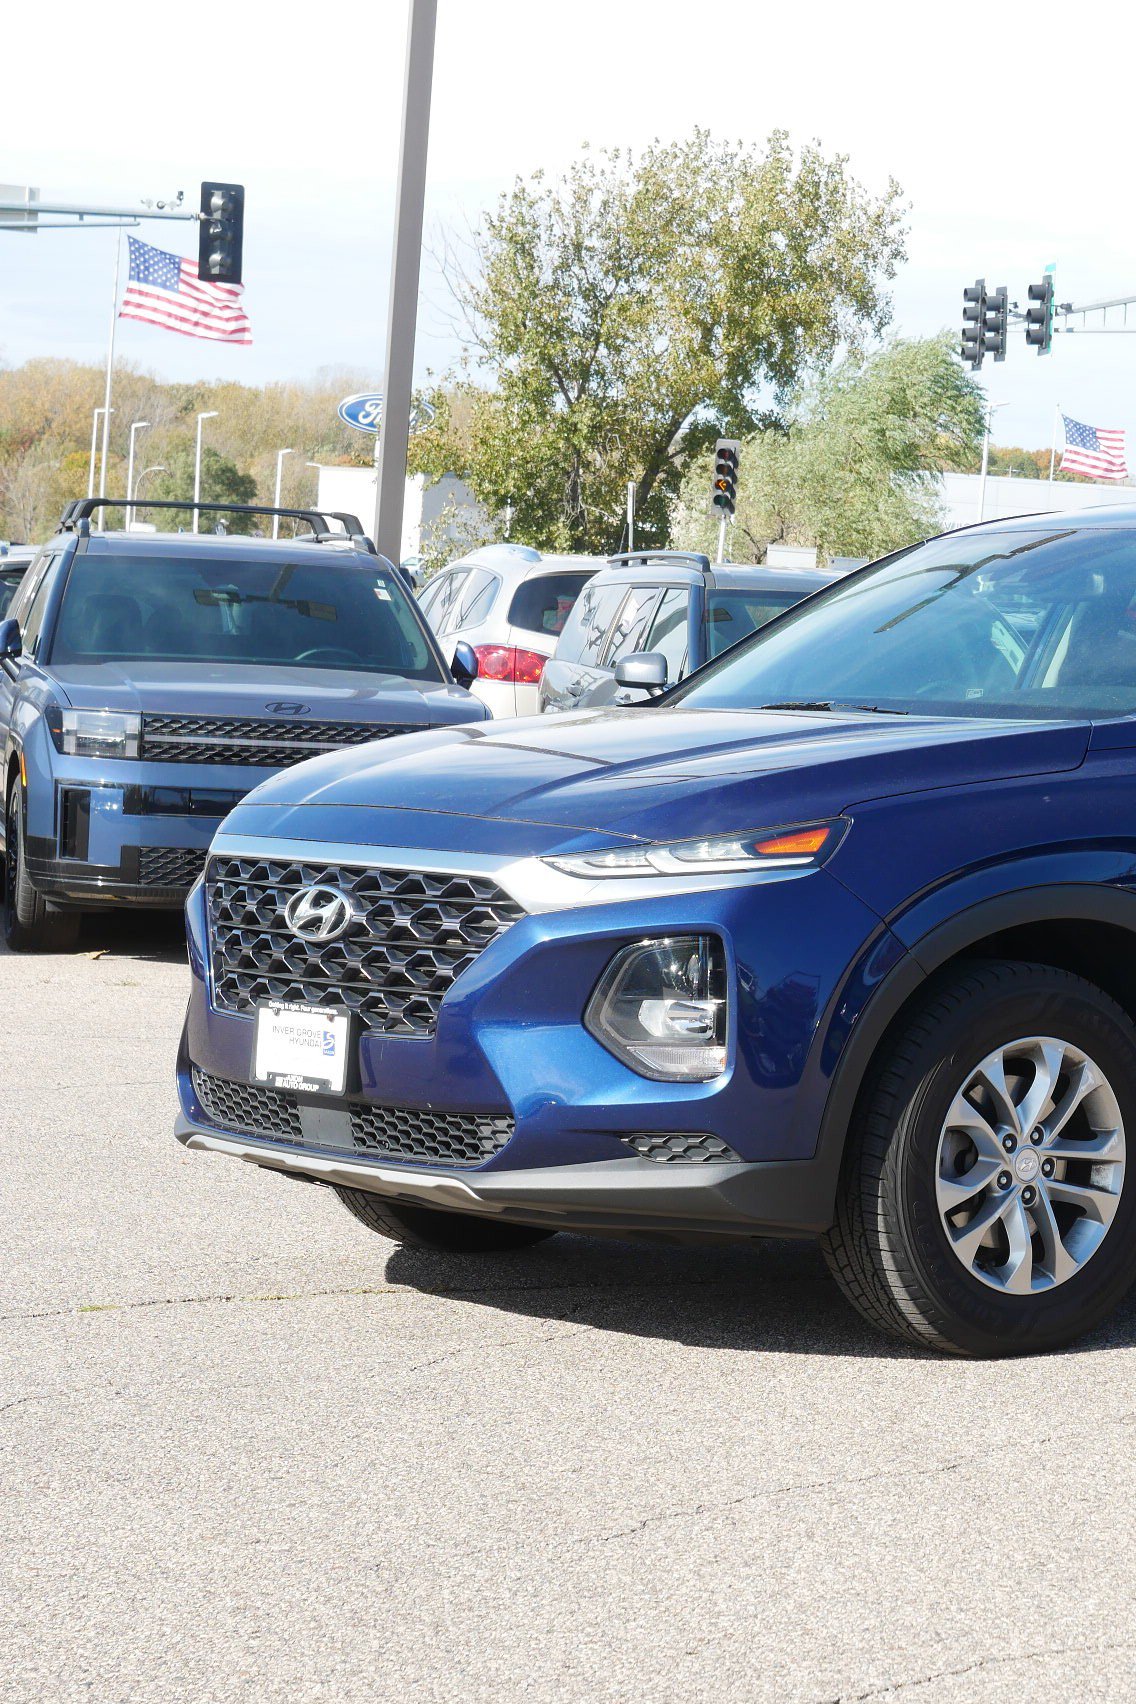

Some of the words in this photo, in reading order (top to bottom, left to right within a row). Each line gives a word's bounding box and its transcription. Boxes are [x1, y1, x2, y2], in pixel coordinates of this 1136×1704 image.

[272, 1025, 294, 1036] INVER
[296, 1028, 321, 1039] GROVE
[289, 1037, 322, 1048] HYUNDAI
